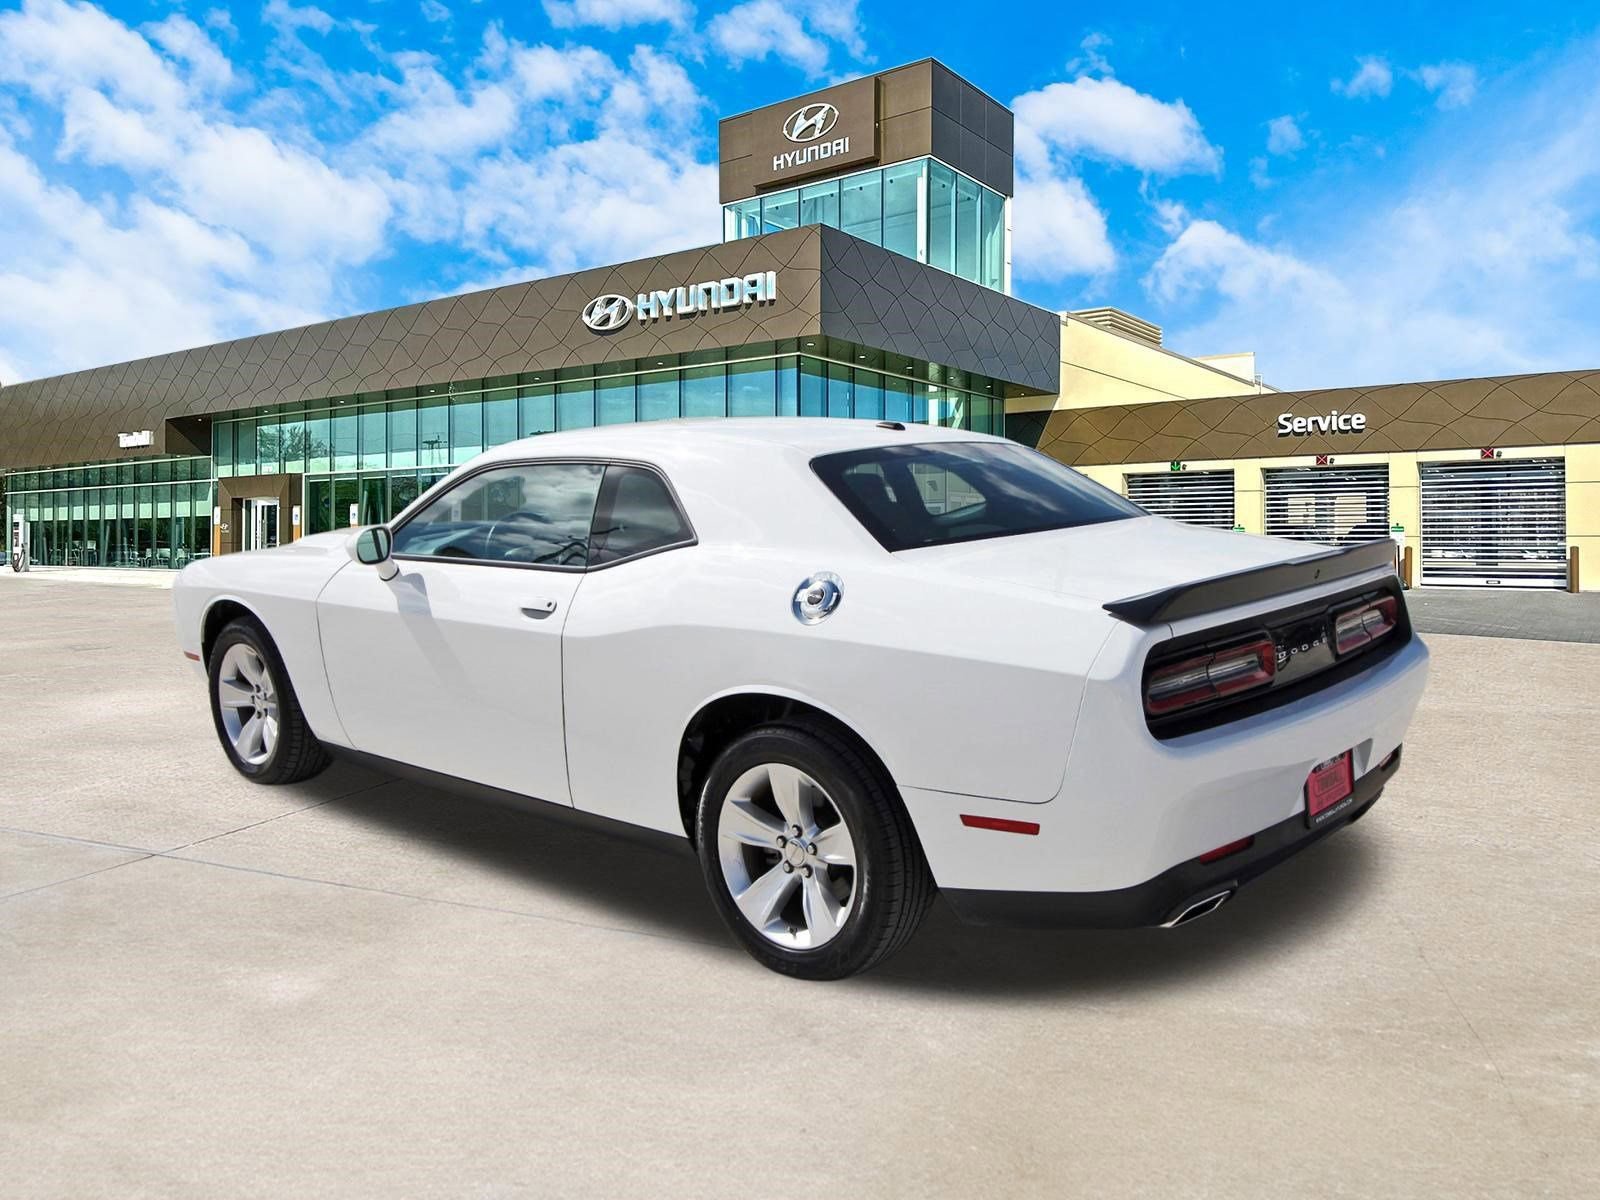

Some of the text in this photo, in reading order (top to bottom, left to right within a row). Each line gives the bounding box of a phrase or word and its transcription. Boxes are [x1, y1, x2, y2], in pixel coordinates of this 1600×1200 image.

[773, 136, 849, 171] HYUNDAI
[636, 271, 776, 321] HYUNDAI
[1277, 410, 1366, 434] Service
